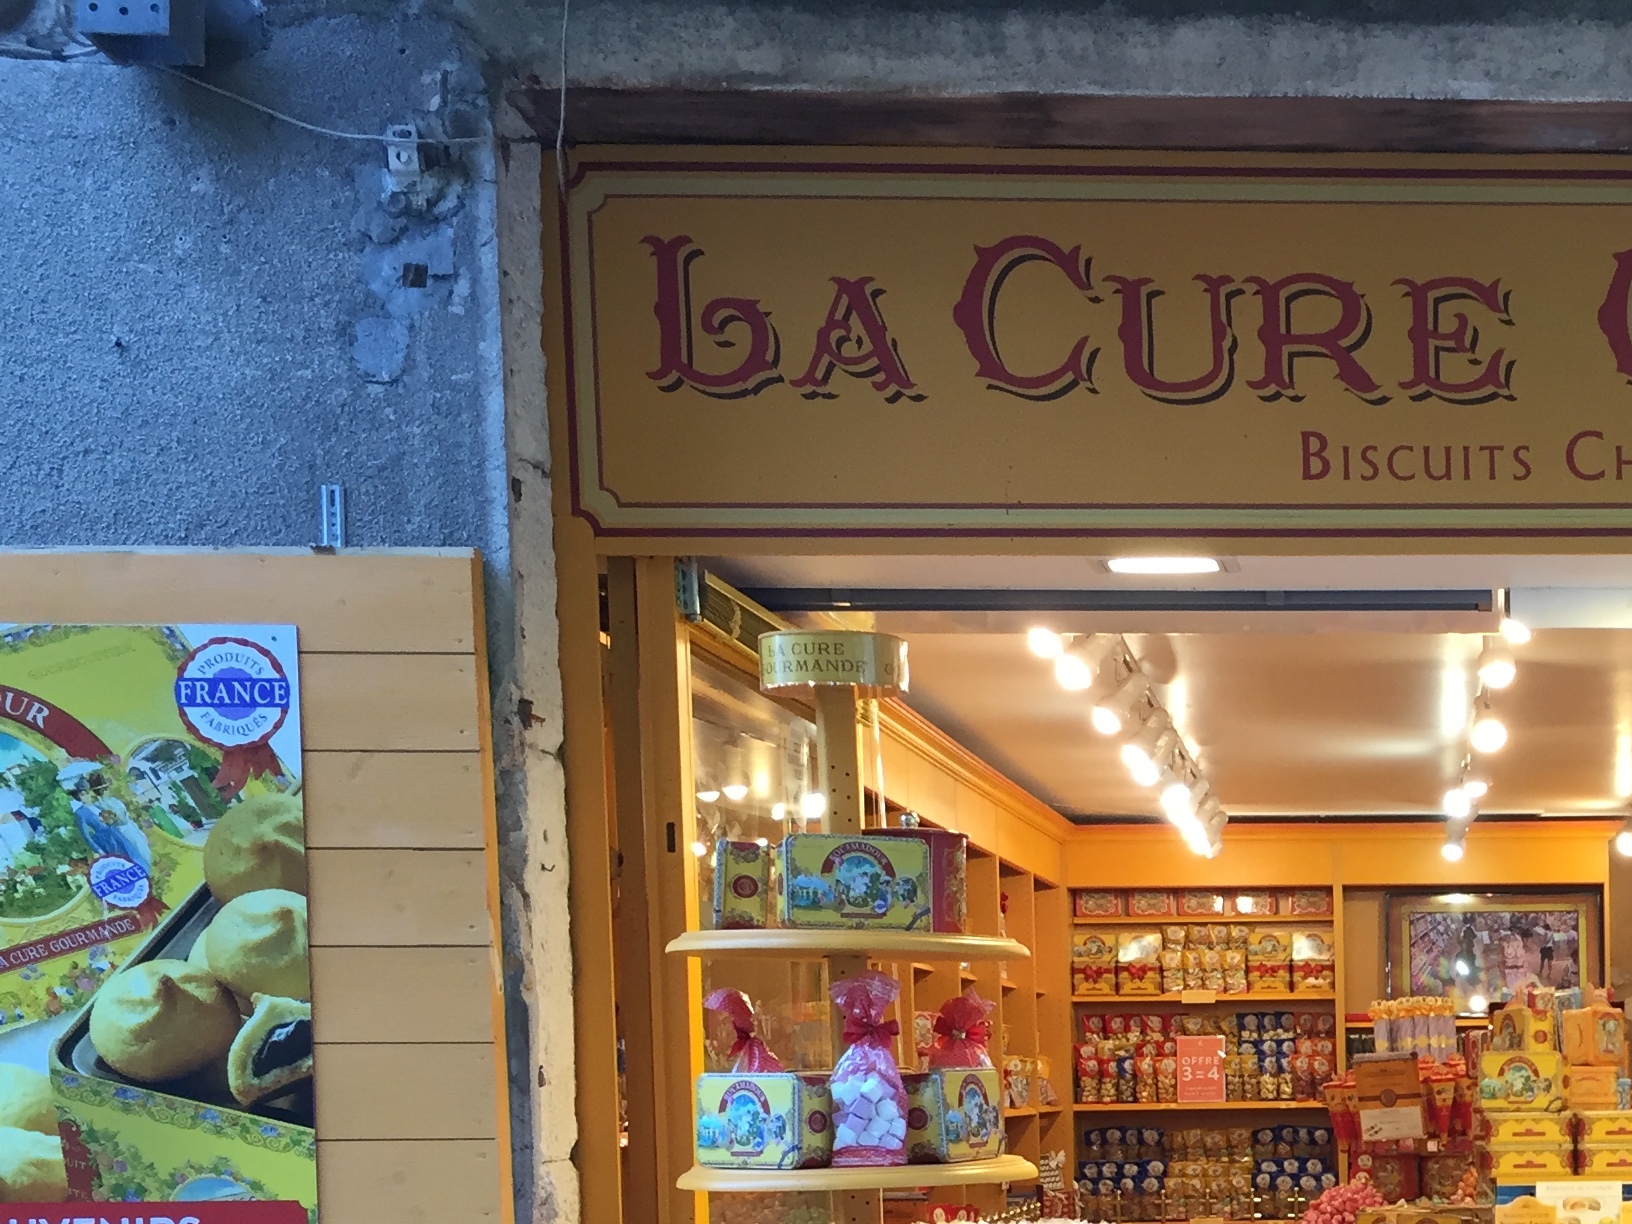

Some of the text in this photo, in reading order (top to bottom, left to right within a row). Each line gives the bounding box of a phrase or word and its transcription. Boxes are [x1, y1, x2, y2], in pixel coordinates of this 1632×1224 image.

[640, 234, 928, 399] LA
[952, 233, 1517, 404] CURE
[1299, 430, 1532, 482] BISCUITS
[197, 652, 265, 677] PRODUITS
[0, 691, 50, 729] UR
[178, 680, 289, 707] FRANCE
[92, 866, 147, 897] FRANCE
[9, 944, 49, 965] CURE
[49, 918, 136, 953] GOURMANDE
[1181, 1056, 1220, 1066] OFFRE
